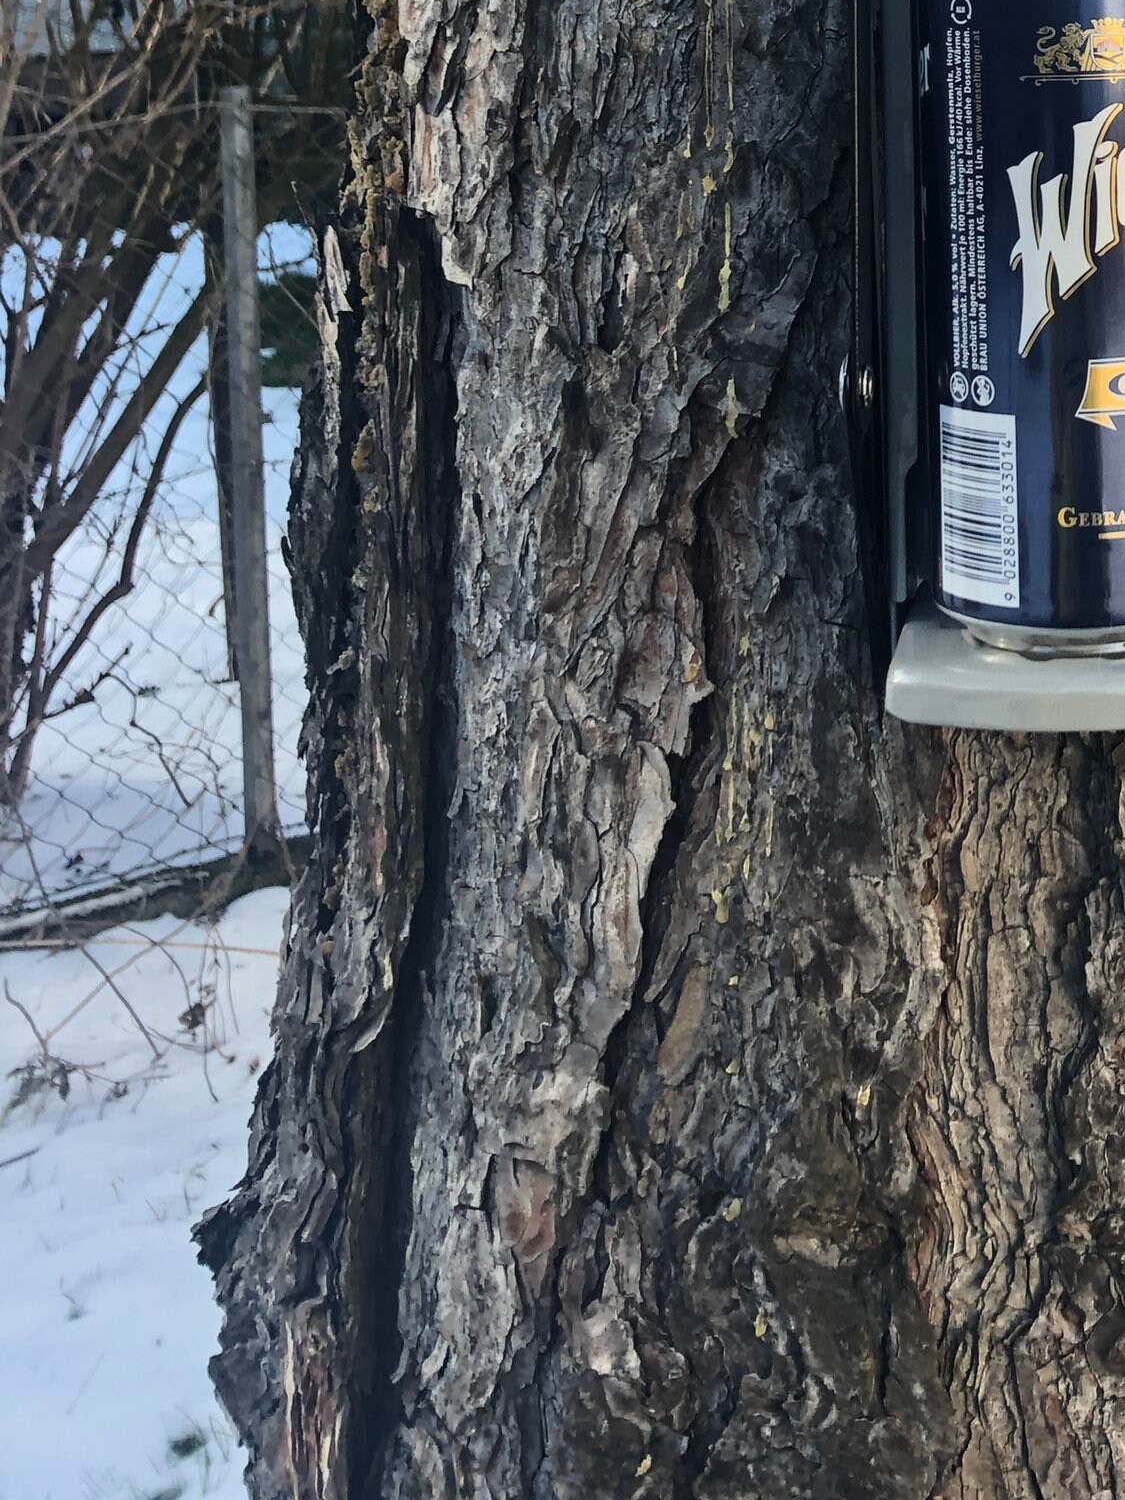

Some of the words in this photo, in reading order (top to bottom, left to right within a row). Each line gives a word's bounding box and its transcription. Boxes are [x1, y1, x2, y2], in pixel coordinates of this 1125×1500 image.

[963, 28, 971, 93] Dosenboden.
[972, 30, 984, 141] www.wieselburger.at
[946, 70, 956, 145] Gerstenmalz,
[964, 97, 972, 124] siehe
[965, 127, 973, 155] Ende:
[975, 146, 984, 169] Linz,
[957, 158, 965, 195] Energie
[976, 175, 984, 211] A-4021
[957, 197, 965, 212] ml:
[966, 178, 974, 215] haltbar
[959, 235, 967, 244] je
[977, 215, 985, 232] AG,
[966, 218, 977, 277] Mindestens
[951, 263, 958, 272] %
[959, 247, 967, 293] Nährwert
[976, 235, 987, 299] ÖSTERREICH
[968, 281, 978, 316] lagern.
[960, 295, 969, 368] Hopfenextrakt.
[978, 304, 987, 338] UNION
[969, 320, 979, 370] geschützt
[979, 343, 988, 371] BRAU
[1002, 439, 1014, 504] 633014
[1003, 514, 1016, 579] 028800
[1004, 592, 1016, 601] 9
